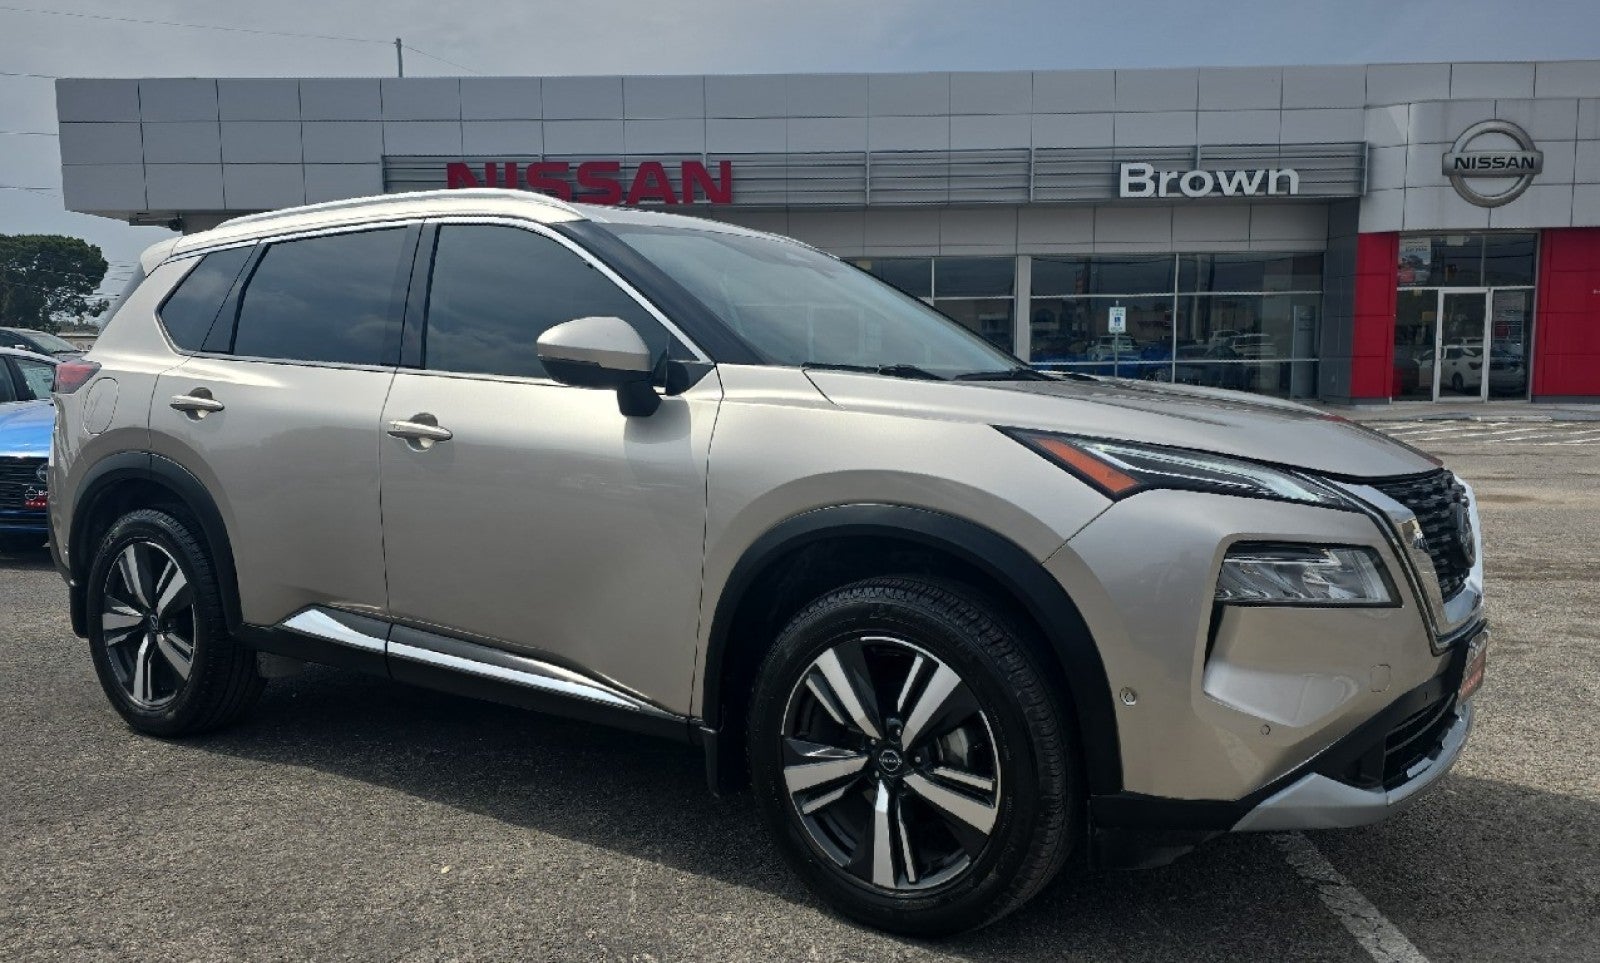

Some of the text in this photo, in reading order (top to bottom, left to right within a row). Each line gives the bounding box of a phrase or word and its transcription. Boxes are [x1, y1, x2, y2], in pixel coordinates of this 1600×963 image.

[1119, 161, 1300, 199] Brown
[1454, 156, 1535, 170] NISSAN
[446, 160, 733, 206] NISSAN
